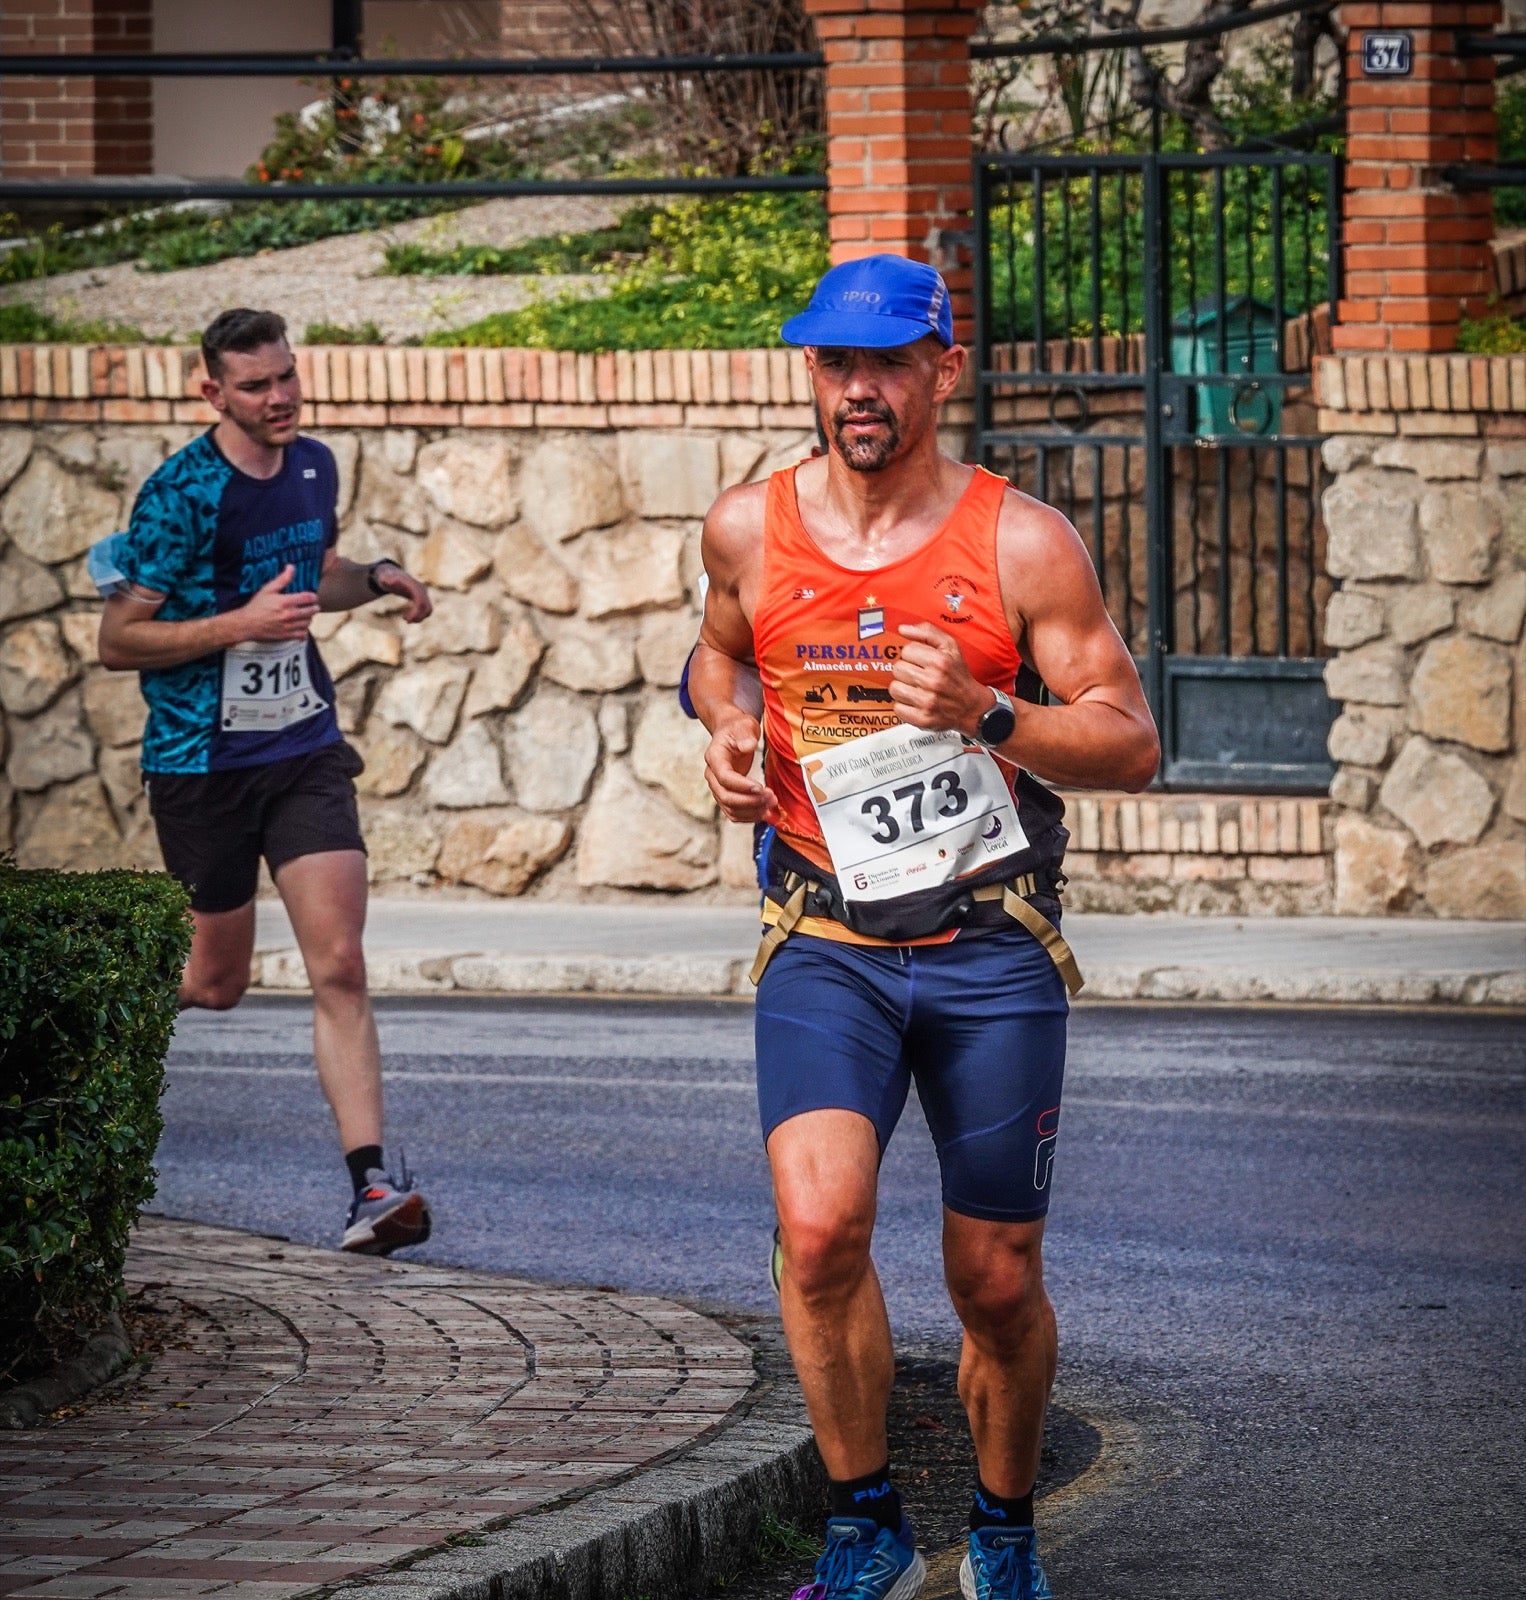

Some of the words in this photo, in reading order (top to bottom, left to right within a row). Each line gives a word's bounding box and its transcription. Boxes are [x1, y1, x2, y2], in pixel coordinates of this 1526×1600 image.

[1371, 38, 1402, 69] 37
[796, 644, 904, 660] PERSIALG
[241, 654, 301, 695] 3116
[803, 661, 852, 672] Almacén
[854, 662, 869, 671] de
[838, 714, 904, 726] EXCAVACIO
[805, 725, 868, 738] FRANCISCO
[861, 771, 968, 844] 373
